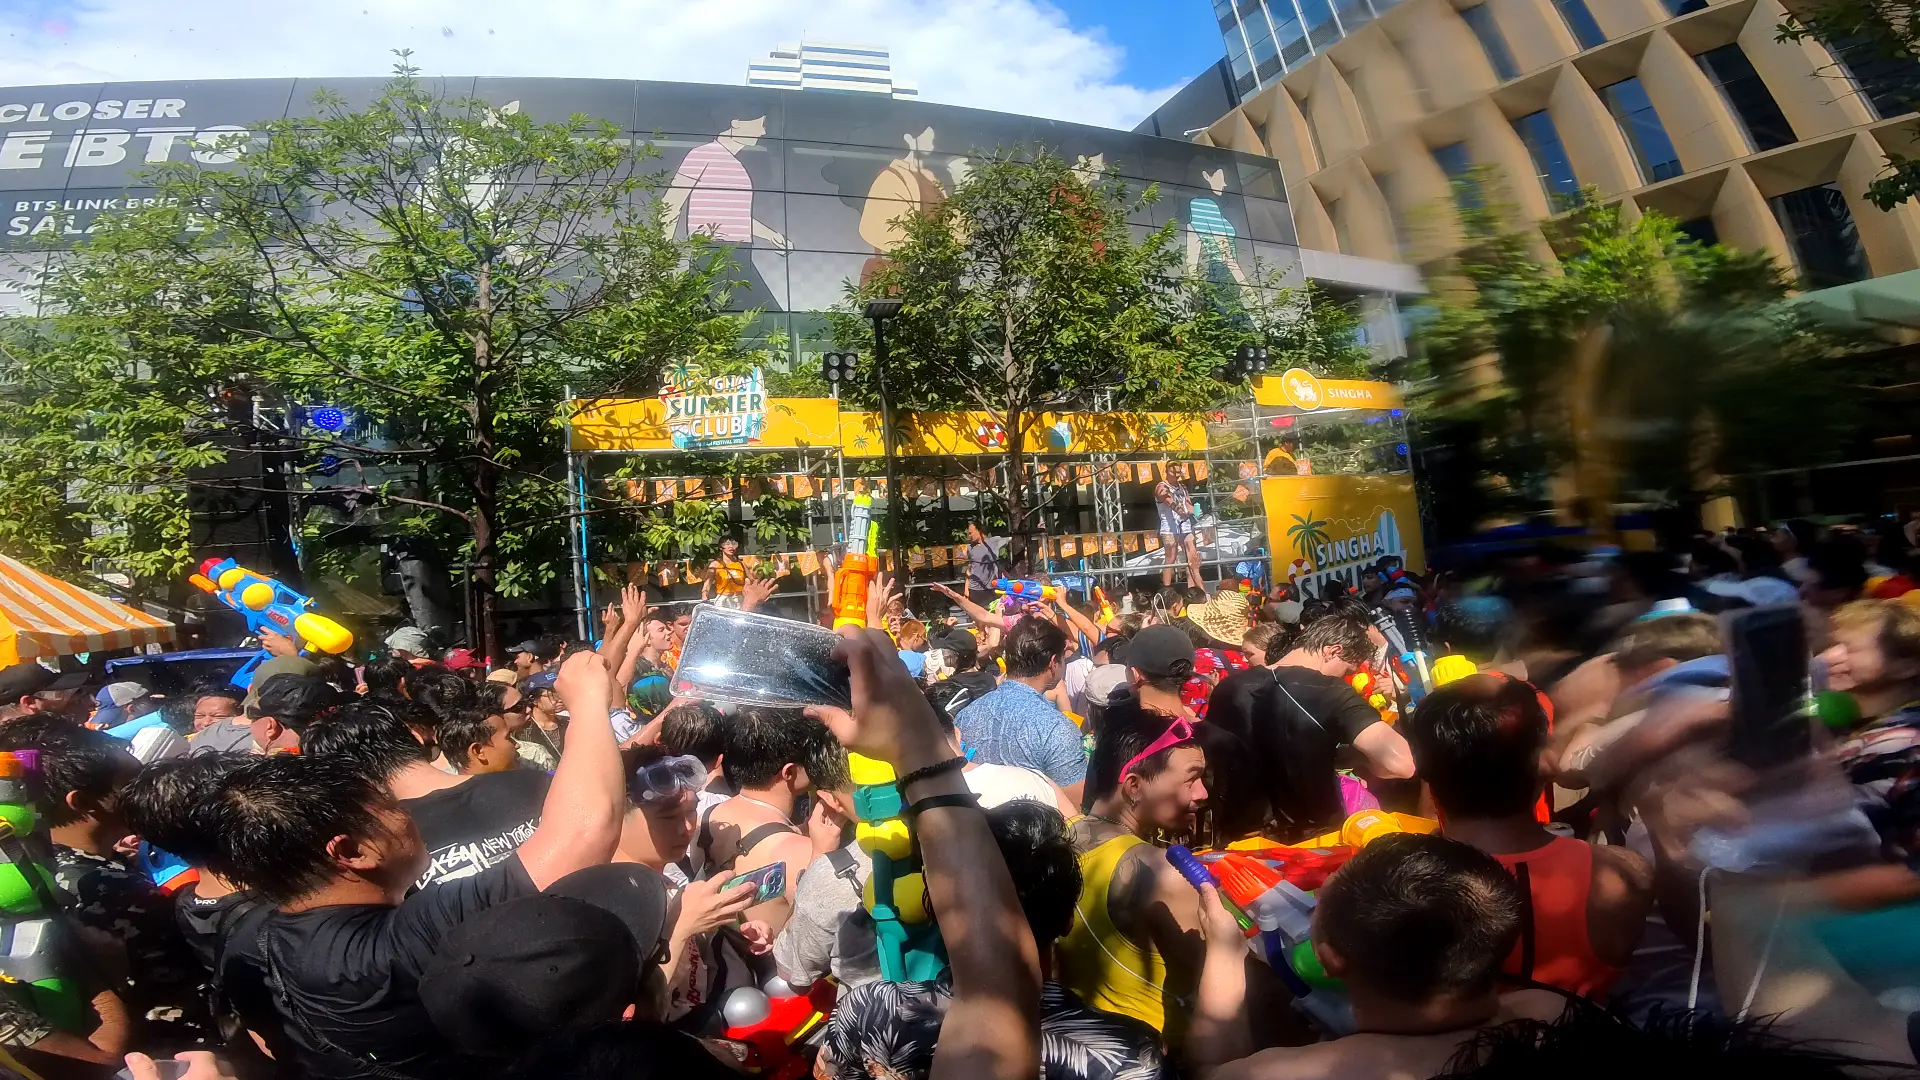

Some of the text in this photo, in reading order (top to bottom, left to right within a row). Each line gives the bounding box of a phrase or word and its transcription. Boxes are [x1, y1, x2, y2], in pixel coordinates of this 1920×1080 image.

[0, 98, 186, 123] CLOSER
[64, 125, 250, 168] BTS
[15, 200, 57, 212] BTS
[64, 198, 119, 211] LINK
[686, 375, 747, 395] SGHA
[1328, 387, 1372, 400] SINGHA
[691, 417, 742, 437] CLUB
[1316, 532, 1384, 566] SINGHA
[481, 832, 512, 857] NEW
